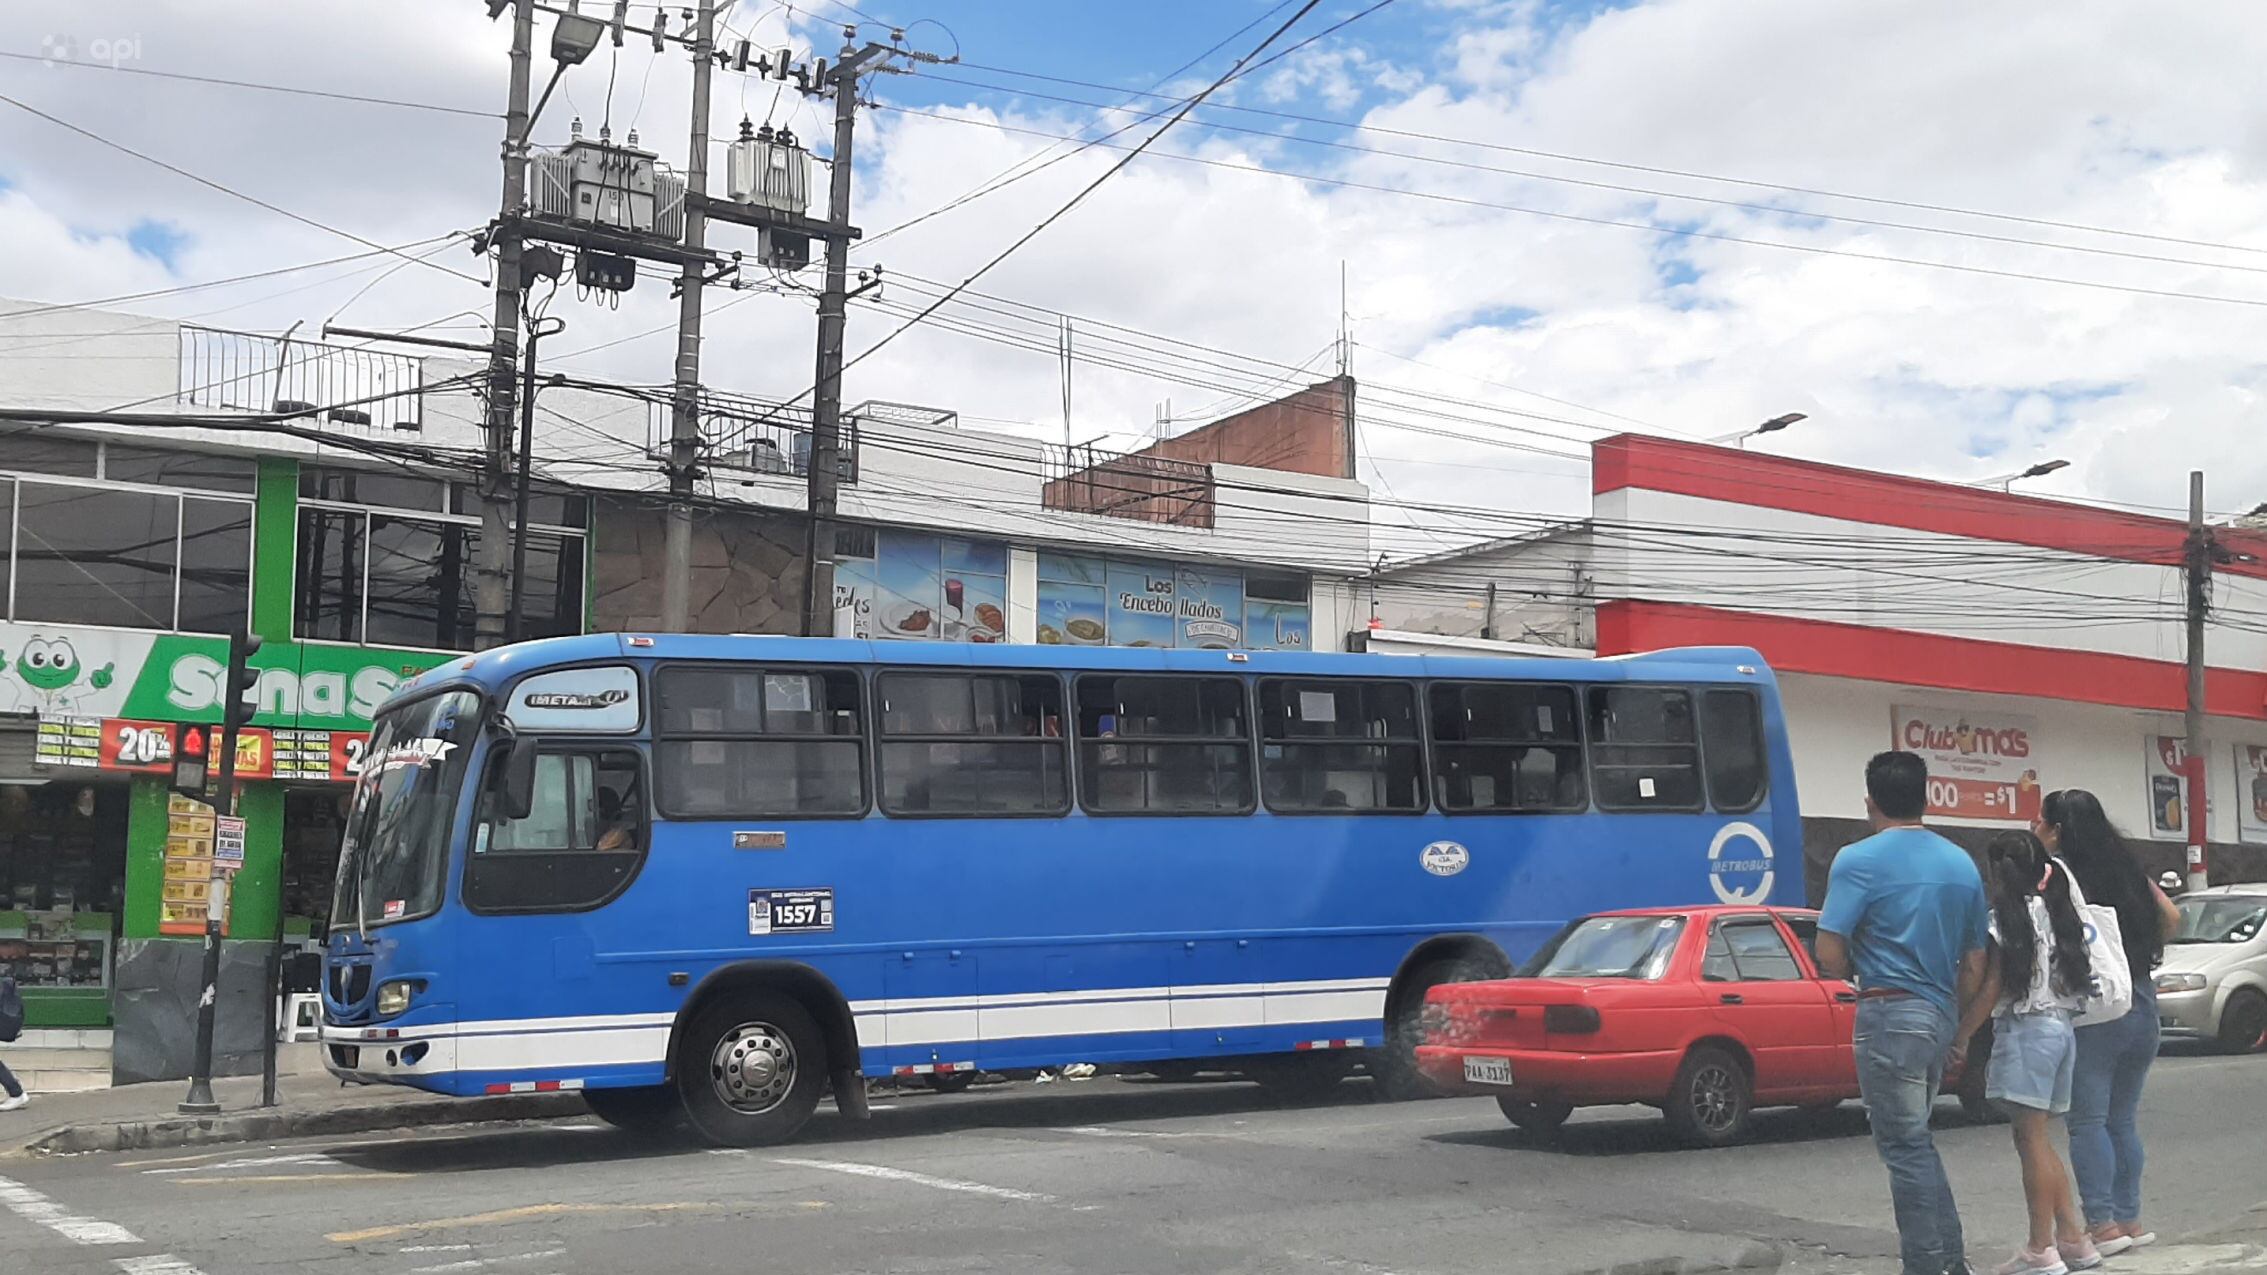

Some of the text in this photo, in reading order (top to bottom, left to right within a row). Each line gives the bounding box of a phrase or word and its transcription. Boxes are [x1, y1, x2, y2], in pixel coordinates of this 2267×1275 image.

[1145, 575, 1173, 594] Los
[1711, 859, 1772, 872] METROBUS
[775, 904, 817, 925] 1557
